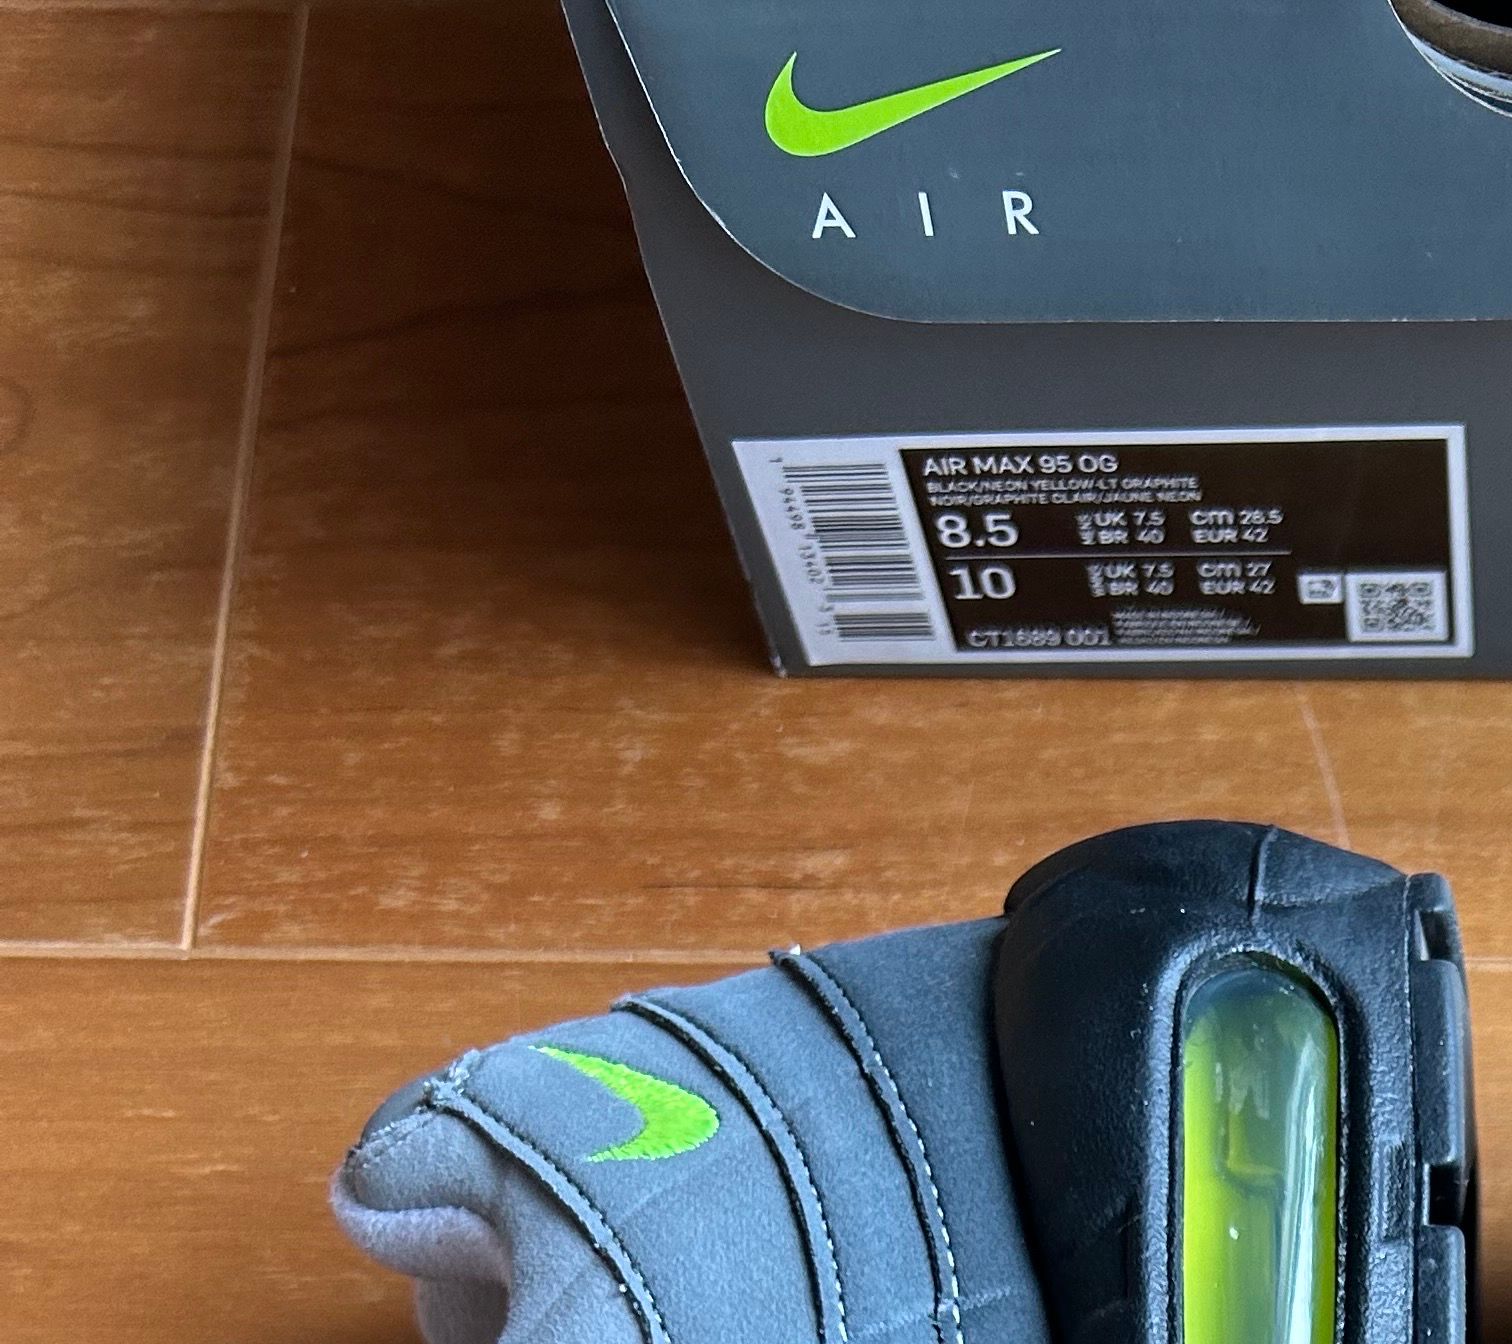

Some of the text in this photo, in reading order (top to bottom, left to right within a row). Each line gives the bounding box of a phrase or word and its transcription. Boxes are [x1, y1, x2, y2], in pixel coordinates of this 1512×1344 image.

[812, 190, 1039, 239] AIR
[923, 454, 1119, 476] AIR MAX 95 OG
[1121, 476, 1198, 490] GRAPHITE
[1094, 511, 1165, 526] UK 7.5
[936, 514, 1018, 548] 8.5
[1097, 528, 1165, 545] BR 40
[1192, 527, 1269, 543] EUR 42
[1104, 563, 1174, 578] UK 7.5
[1246, 561, 1272, 577] 27
[949, 566, 1016, 599] 10
[1146, 579, 1174, 595] 40
[1200, 578, 1276, 594] EUR 42
[967, 628, 1062, 647] CT1689
[1065, 627, 1111, 646] 001
